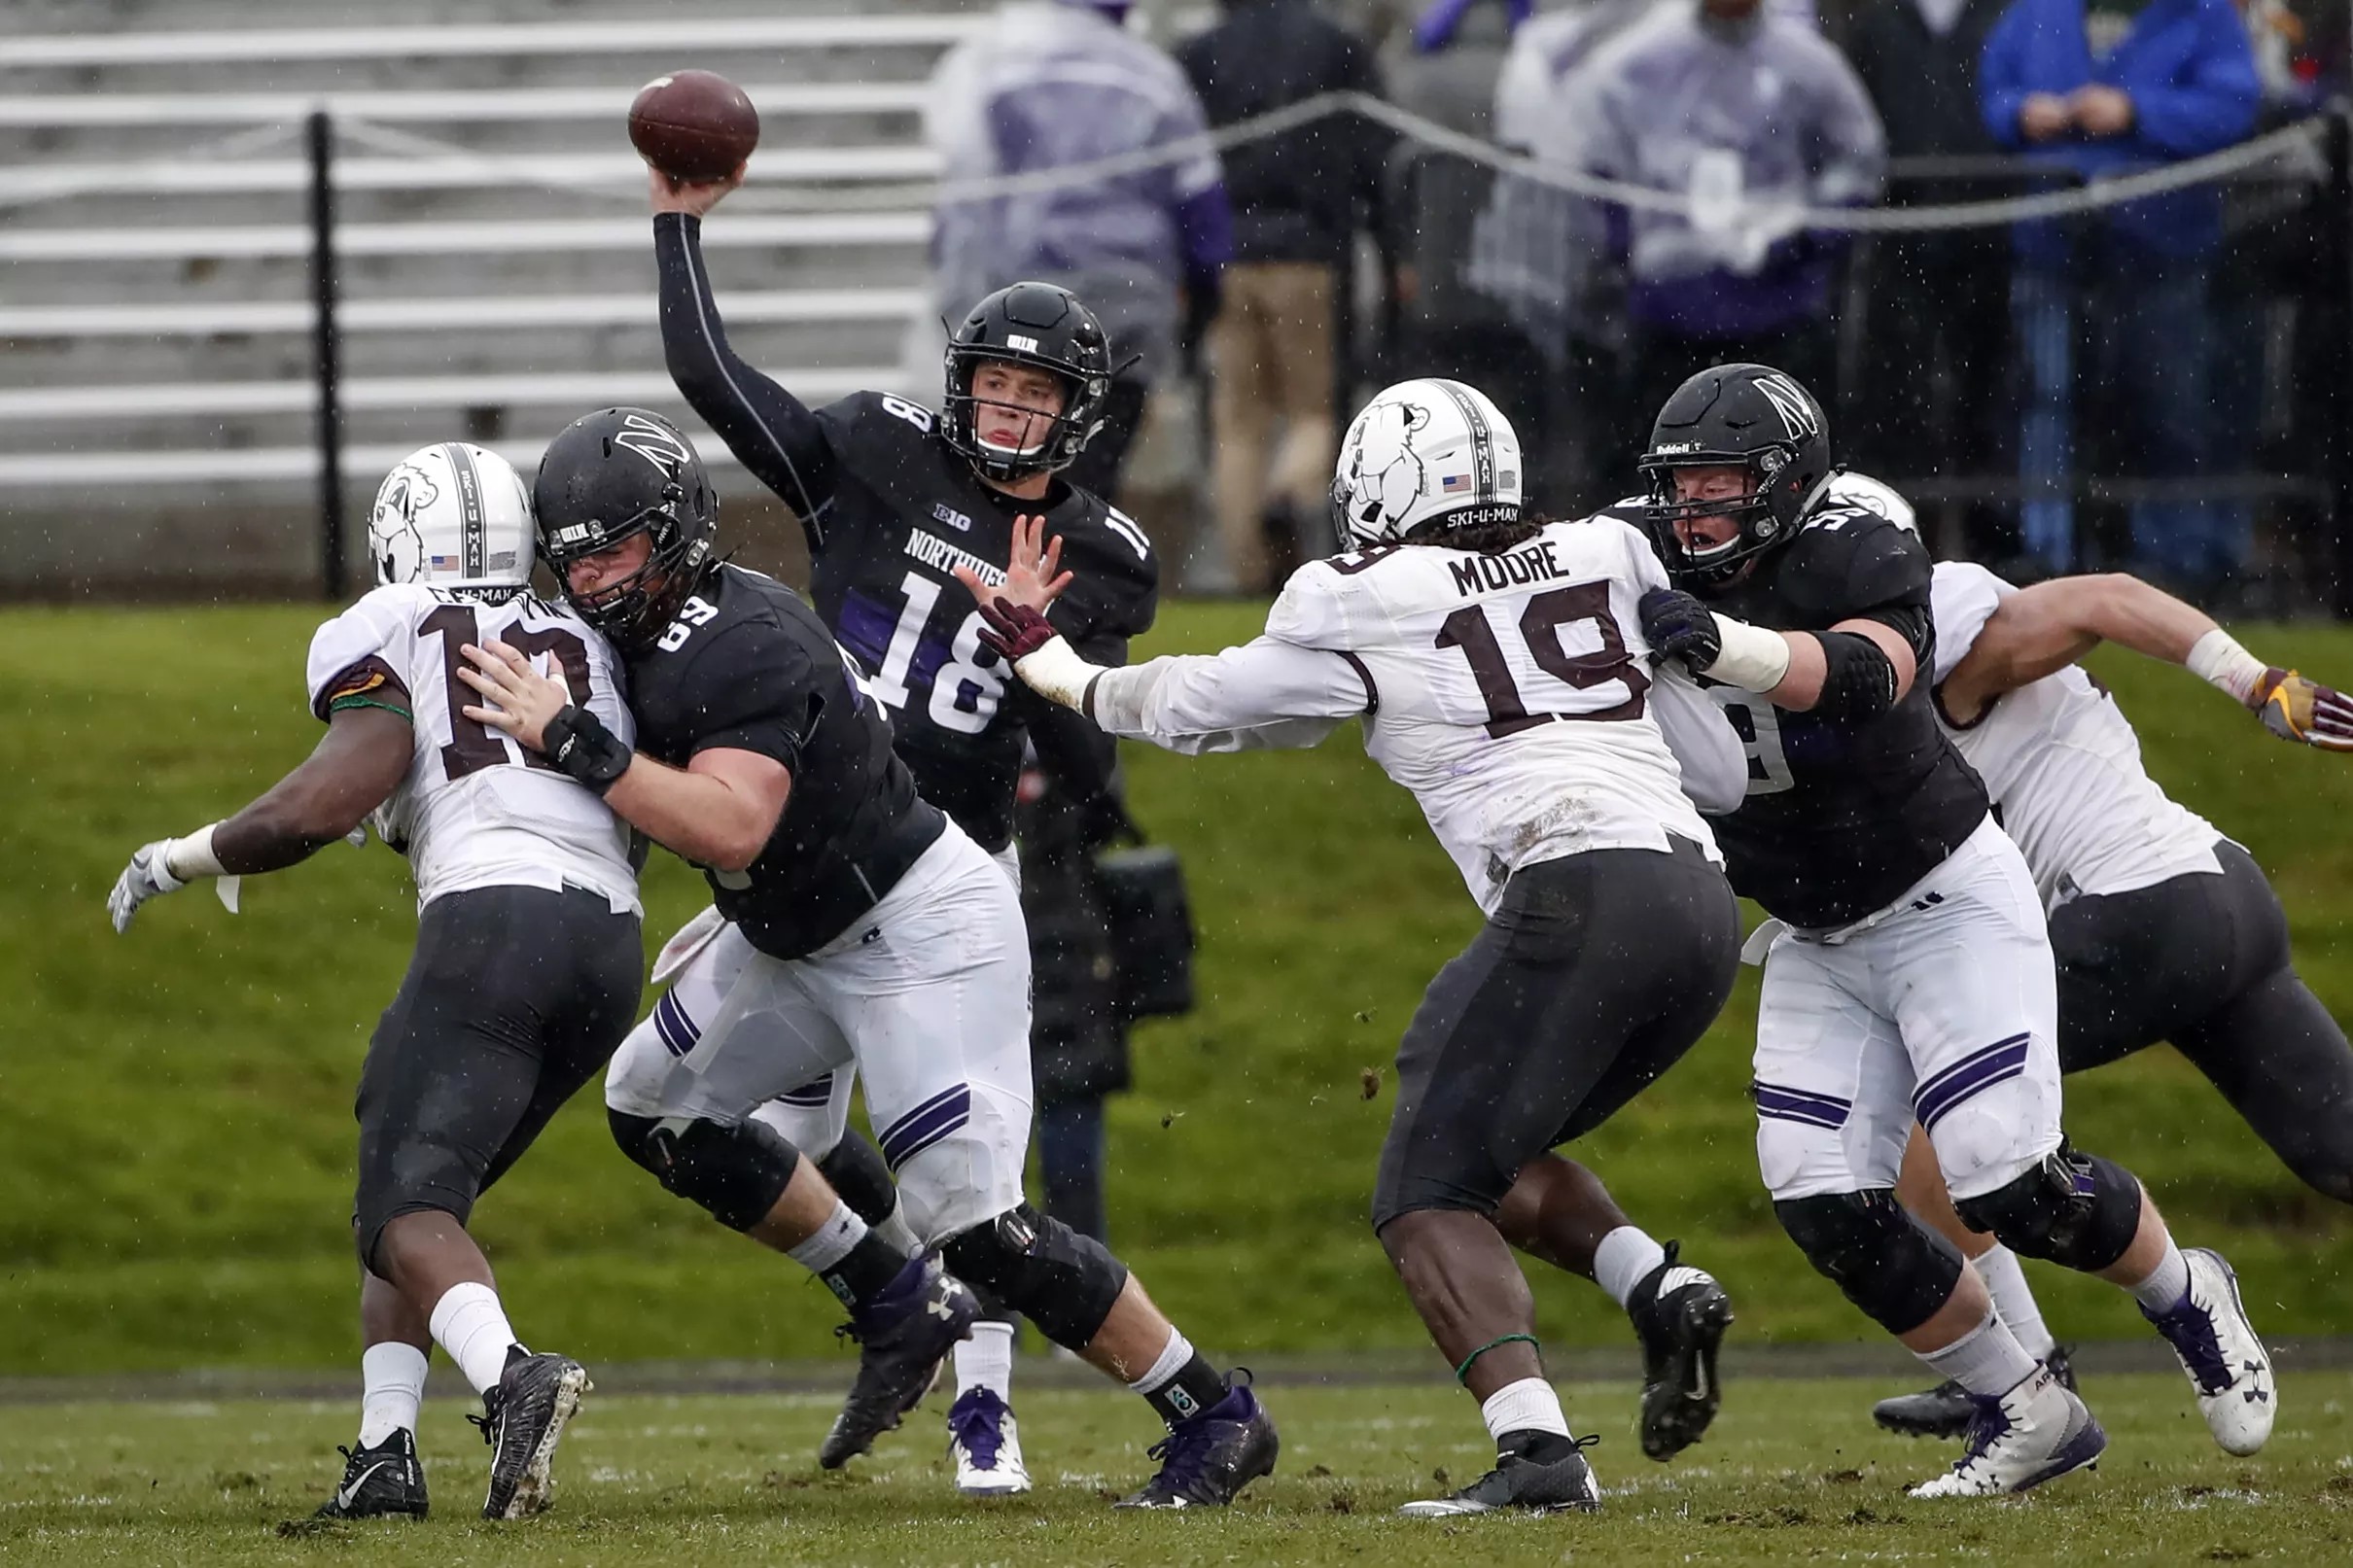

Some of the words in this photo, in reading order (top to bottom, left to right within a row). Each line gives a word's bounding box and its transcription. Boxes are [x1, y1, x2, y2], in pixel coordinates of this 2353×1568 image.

[461, 470, 480, 567] SKI-U-MAH
[1447, 507, 1519, 528] SKI-U-MAH
[1447, 540, 1570, 598] MOORE
[868, 570, 1013, 734] 18
[1434, 578, 1652, 741] 19
